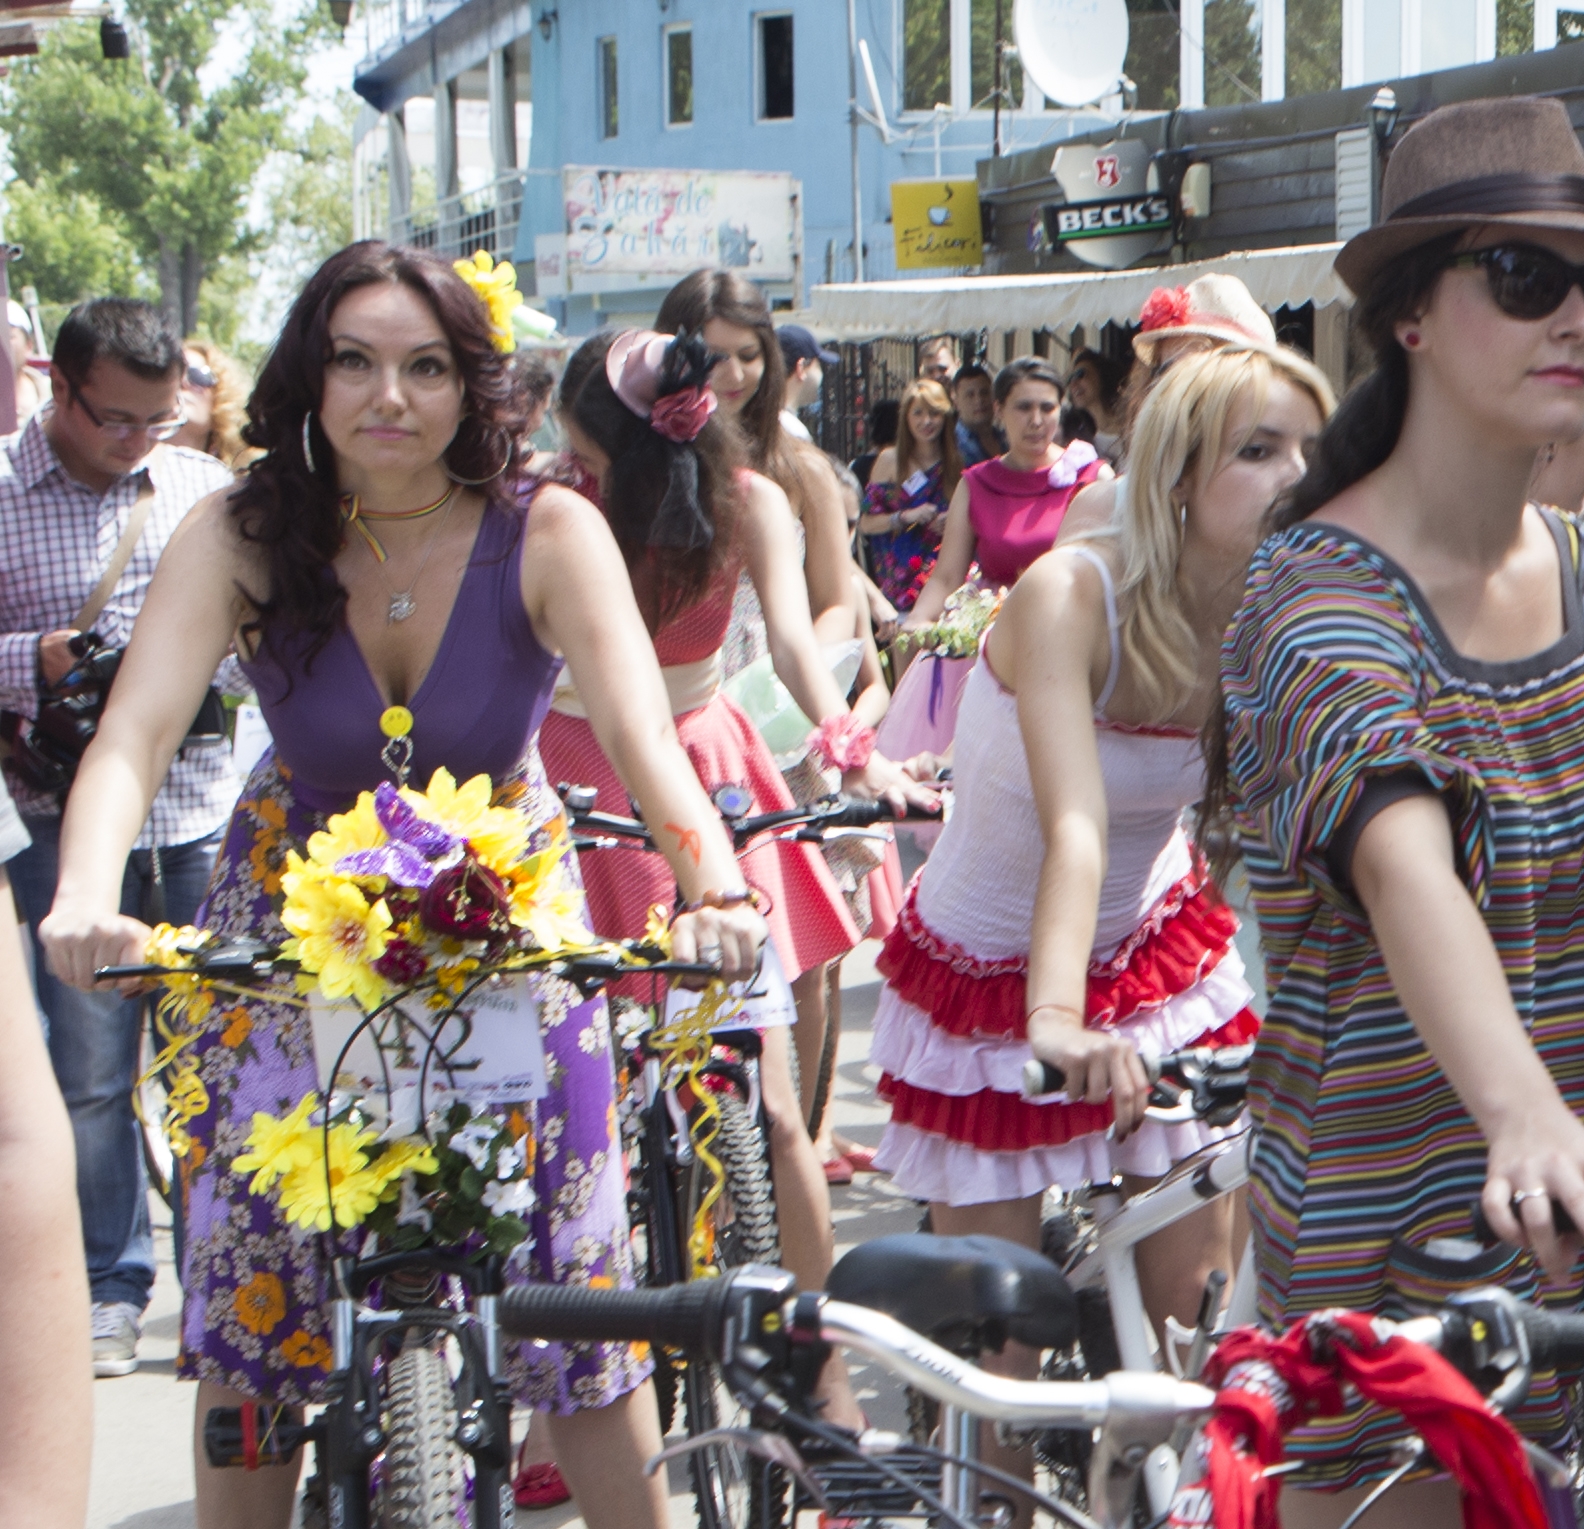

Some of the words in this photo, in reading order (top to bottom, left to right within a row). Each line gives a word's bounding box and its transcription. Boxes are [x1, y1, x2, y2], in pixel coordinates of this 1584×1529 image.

[677, 179, 711, 216] de
[1058, 198, 1170, 232] BECK'S
[377, 1008, 484, 1070] 42
